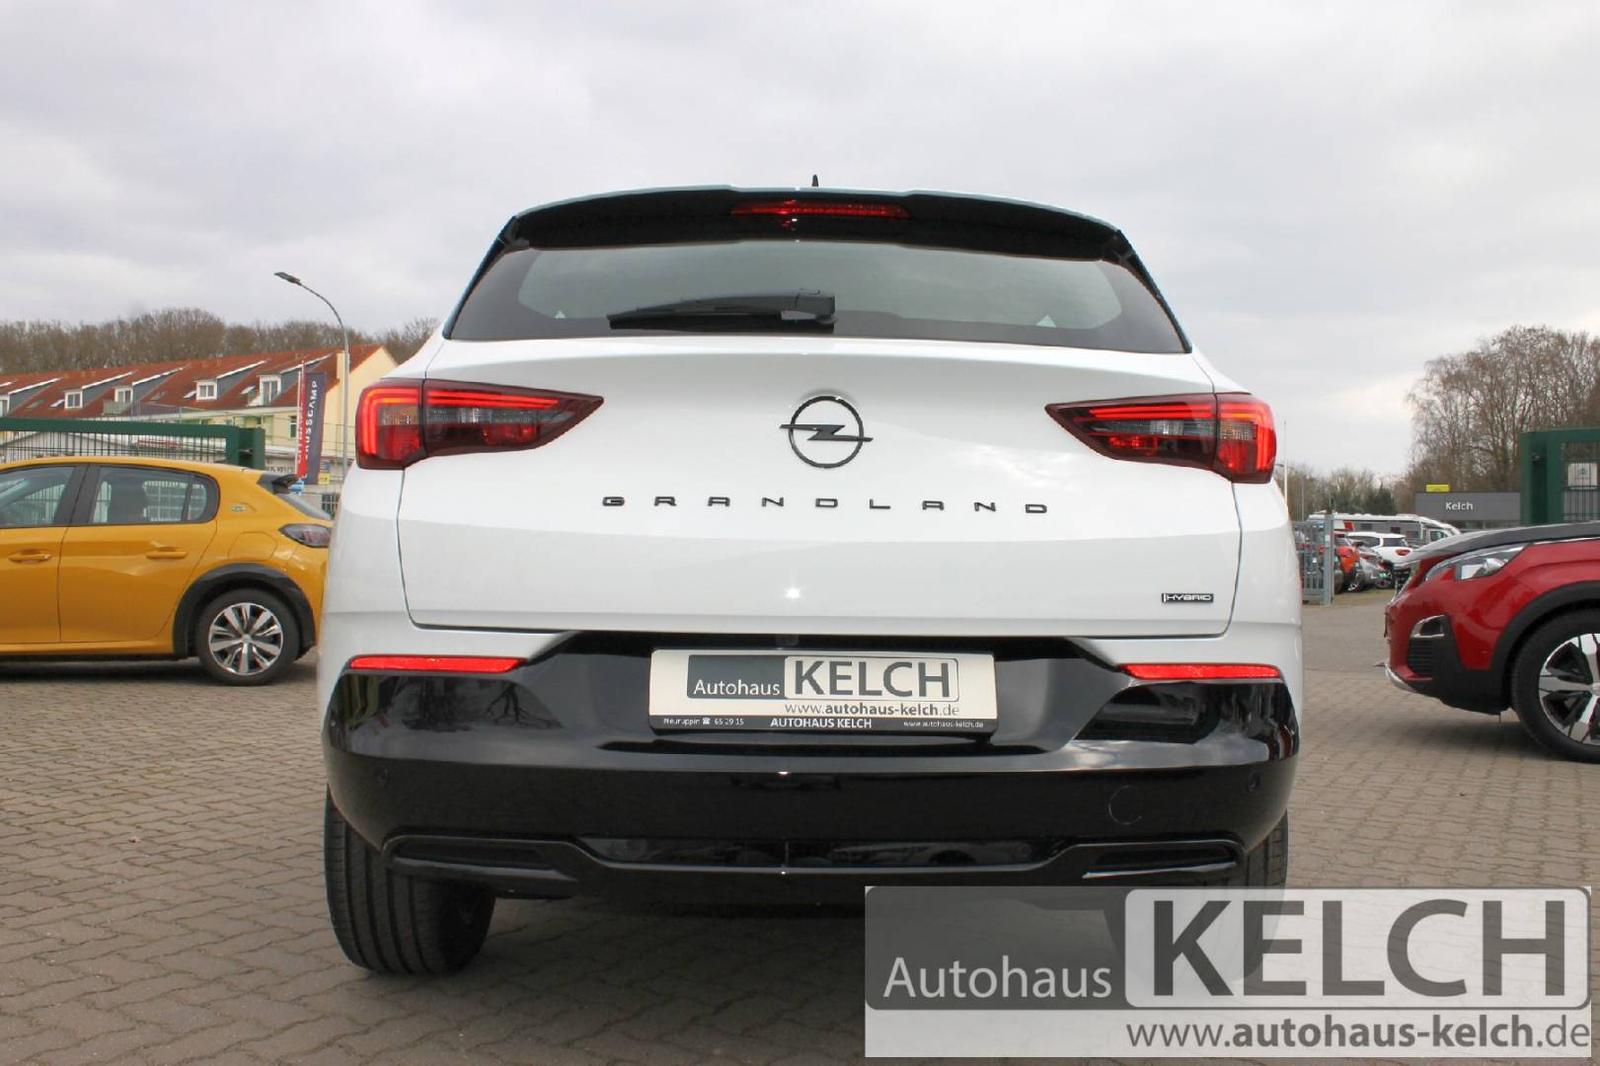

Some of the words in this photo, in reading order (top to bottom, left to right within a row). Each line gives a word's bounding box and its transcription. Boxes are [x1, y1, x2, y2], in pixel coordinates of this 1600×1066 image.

[602, 495, 1048, 513] GRANDLAND
[1445, 501, 1473, 510] Kelch
[1166, 593, 1212, 601] HYBRID
[693, 679, 781, 697] Autohaus
[794, 660, 950, 698] KELCH
[784, 702, 960, 717] www.autohaus-kelch.de
[770, 717, 835, 729] AUTOHAUS
[837, 719, 872, 730] KELCH
